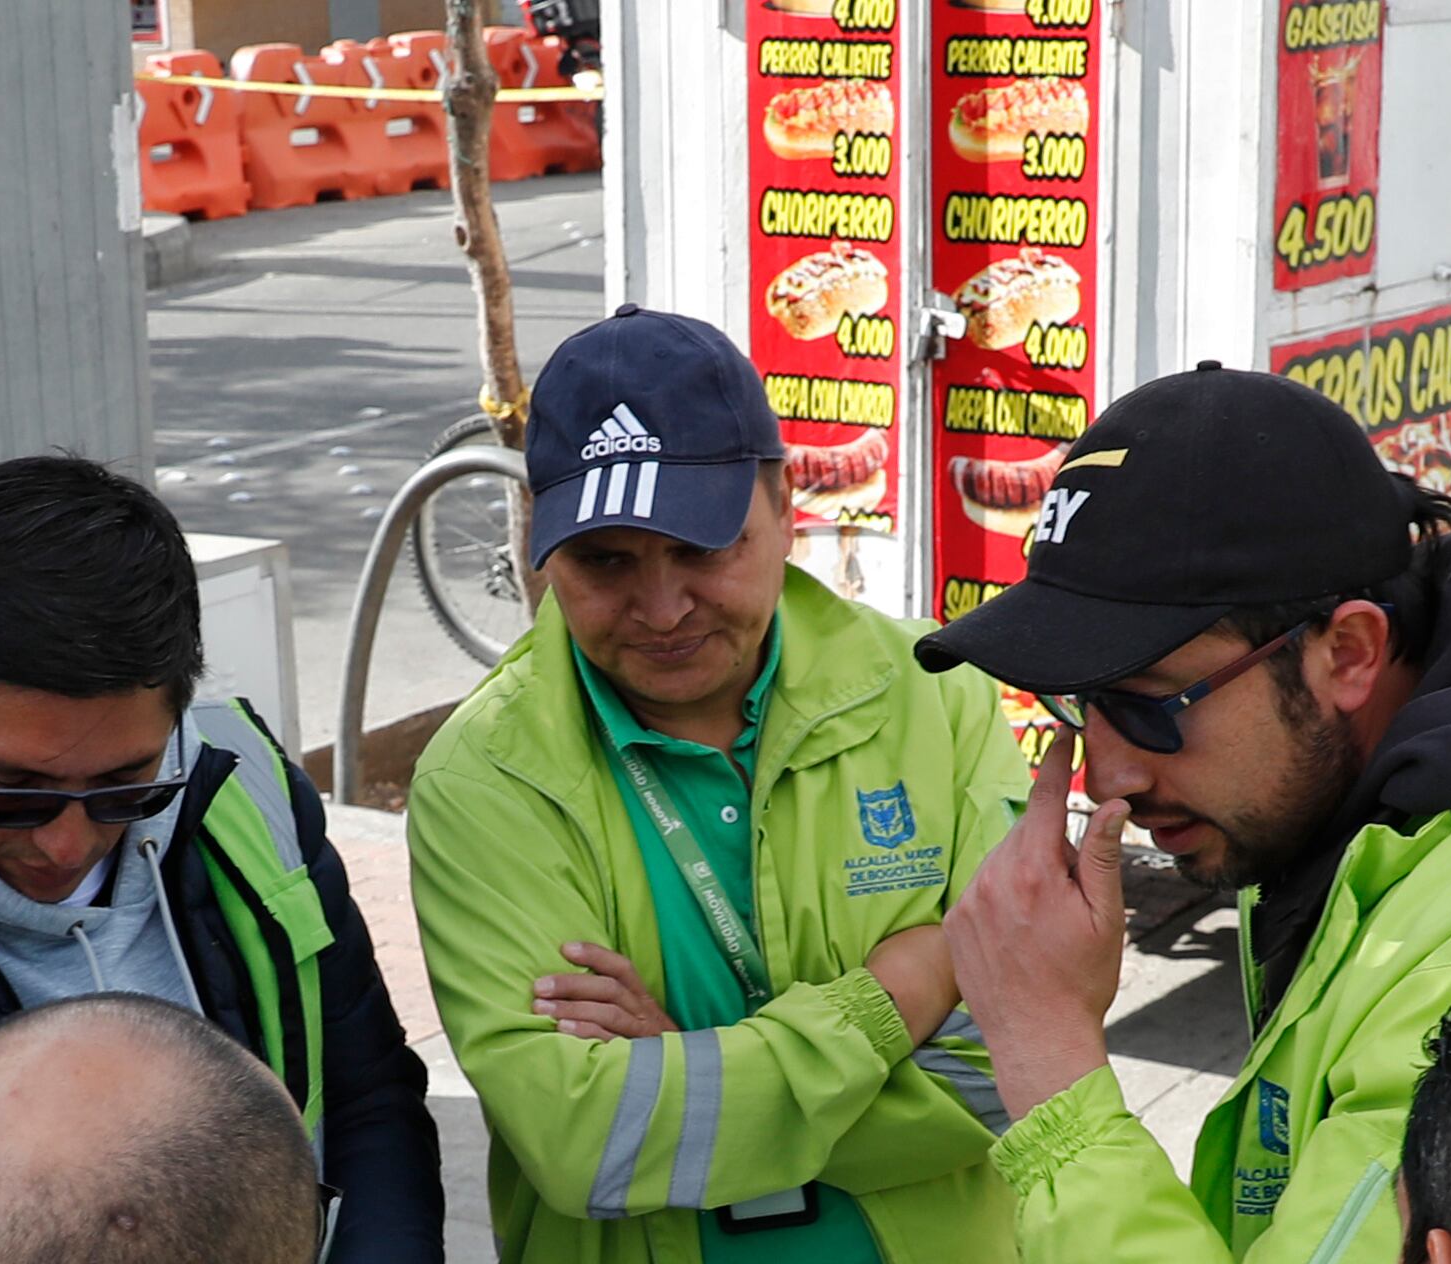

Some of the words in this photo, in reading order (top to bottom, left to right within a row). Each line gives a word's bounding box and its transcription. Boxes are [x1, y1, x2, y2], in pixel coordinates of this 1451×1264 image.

[833, 0, 895, 29] 4.000
[1025, 0, 1092, 26] 4.000
[1286, 0, 1380, 48] GASEOSA
[759, 40, 820, 75] PERROS
[821, 41, 892, 78] CALIENTE
[947, 39, 1011, 74] PERROS
[1013, 40, 1087, 76] CALIENTE
[833, 134, 891, 176] 3.000
[1023, 135, 1086, 179] 3.000
[762, 190, 894, 240] CHORIPERRO
[946, 195, 1088, 247] CHORIPERRO
[1277, 194, 1374, 268] 4.500
[837, 315, 895, 356] 4.000
[1025, 325, 1088, 368] 4.000
[810, 377, 840, 422] CON
[1286, 337, 1405, 427] RROS
[945, 386, 995, 433] AREPA
[581, 434, 661, 460] adidas
[1034, 487, 1091, 544] EY
[702, 889, 740, 953] MOVILIDAD
